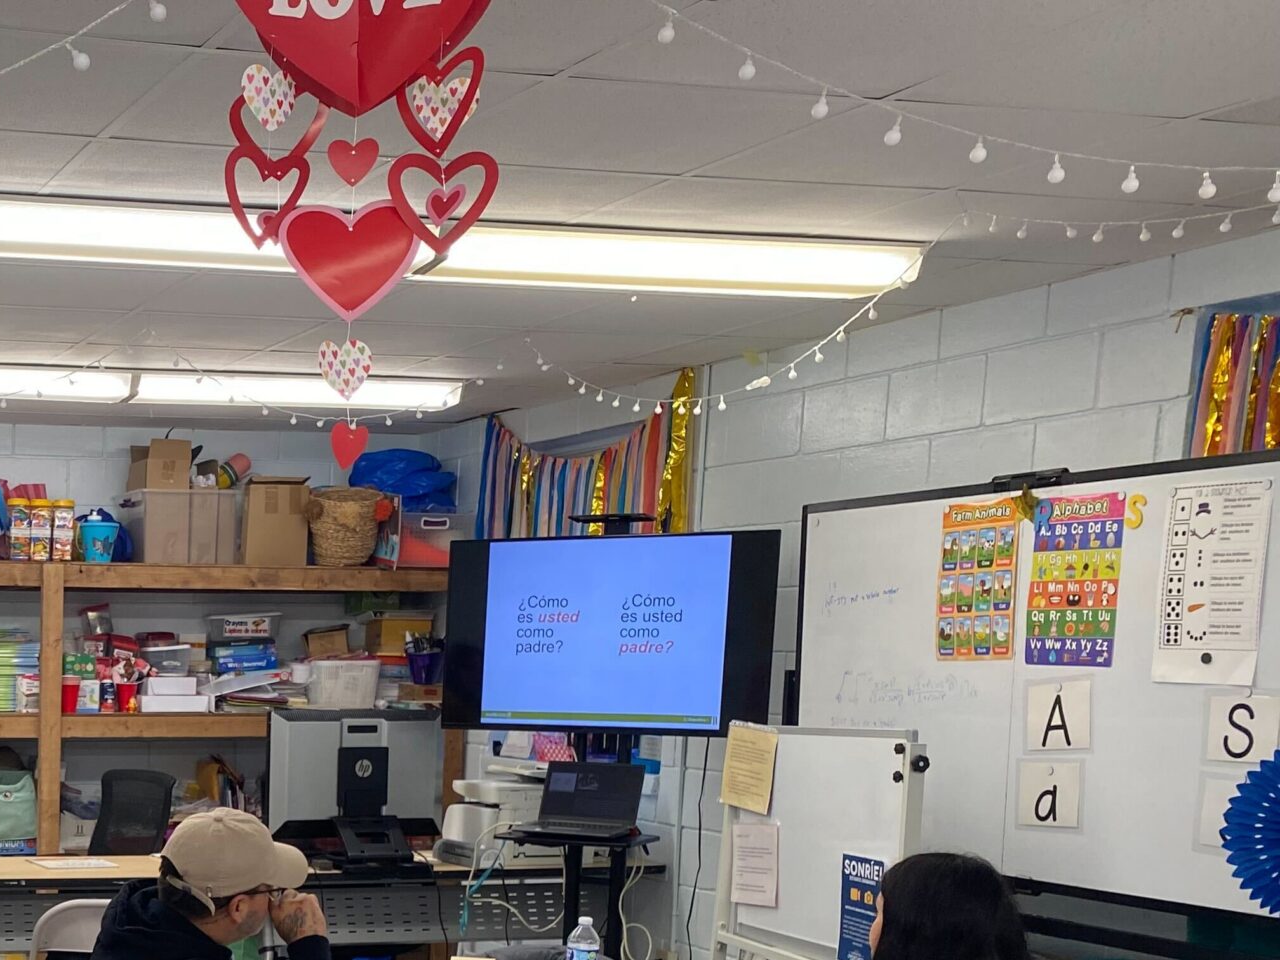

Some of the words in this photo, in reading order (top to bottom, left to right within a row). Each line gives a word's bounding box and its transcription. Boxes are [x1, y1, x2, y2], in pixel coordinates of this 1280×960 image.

[952, 508, 973, 521] Farm
[974, 506, 1011, 519] Animals
[1053, 500, 1108, 518] Alphabet
[1125, 494, 1147, 529] S
[1055, 524, 1067, 536] Bb
[1071, 523, 1083, 534] Cc
[1088, 522, 1101, 533] Dd
[1106, 521, 1118, 532] Ee
[1037, 554, 1046, 563] Ff
[1049, 554, 1062, 565] Gg
[1065, 553, 1077, 563] Hh
[1092, 552, 1100, 564] Jj
[1105, 551, 1116, 560] Kk
[1034, 583, 1043, 593] Ll
[1048, 582, 1063, 593] Mm
[1067, 582, 1080, 592] Nn
[1084, 581, 1097, 592] Oo
[518, 595, 569, 611] ¿Cómo
[621, 593, 676, 610] ¿Cómo
[517, 613, 534, 623] es
[538, 610, 580, 623] usted
[620, 612, 637, 623] es
[642, 609, 683, 623] usted
[1031, 611, 1044, 623] Qq
[1049, 611, 1061, 620] Rr
[1066, 610, 1077, 620] Ss
[1083, 610, 1093, 620] Tt
[1098, 610, 1111, 621] Uu
[516, 628, 553, 639] como
[619, 627, 660, 638] como
[515, 640, 564, 656] padre?
[618, 640, 674, 656] padre?
[1030, 639, 1042, 650] Vv
[1045, 639, 1062, 650] Ww
[1065, 639, 1077, 650] Xx
[1080, 639, 1092, 652] Yy
[1096, 639, 1108, 650] Zz
[1041, 694, 1072, 748] A
[1223, 703, 1255, 759] S
[358, 760, 370, 777] hp
[1034, 785, 1058, 822] a
[844, 859, 883, 881] SONRÍE!
